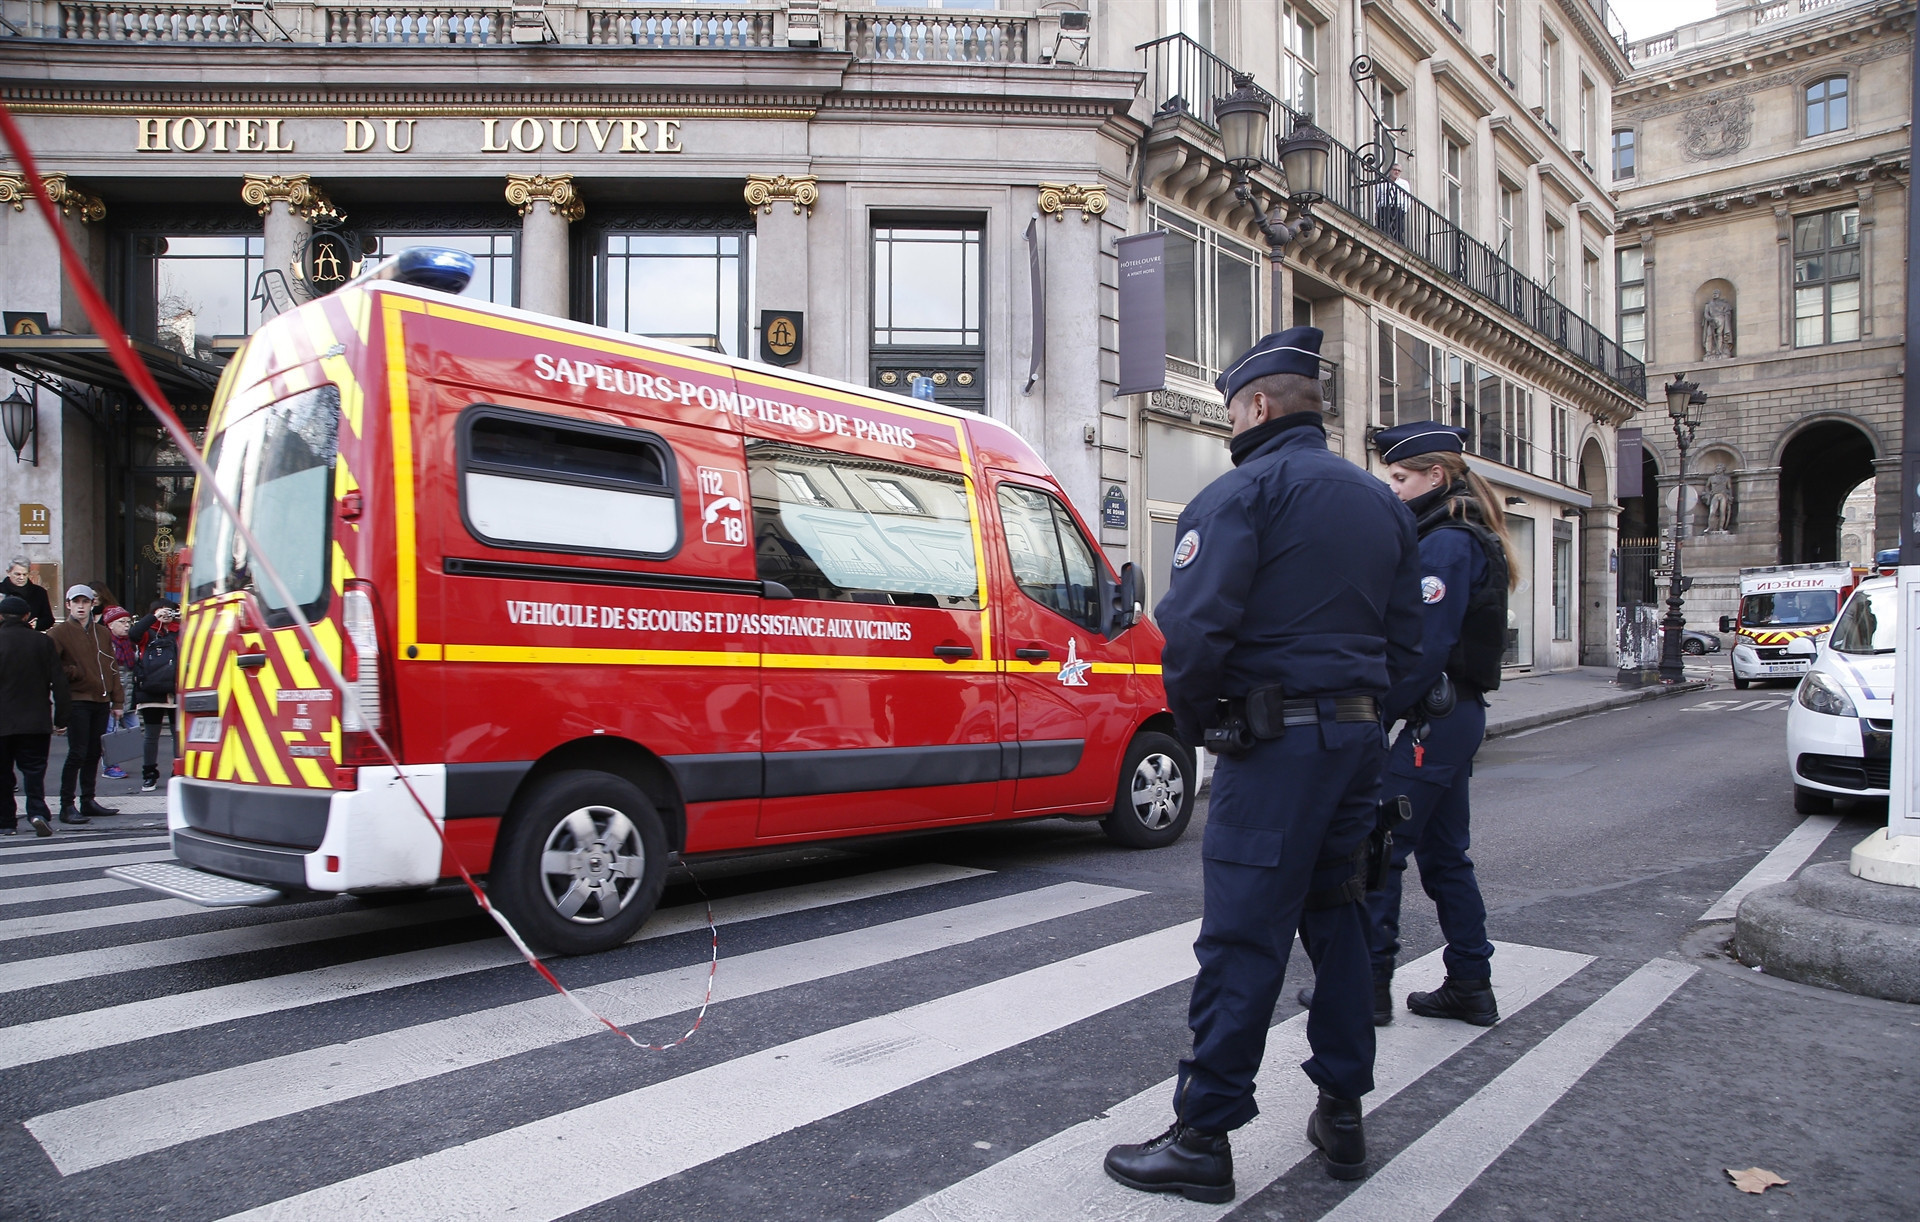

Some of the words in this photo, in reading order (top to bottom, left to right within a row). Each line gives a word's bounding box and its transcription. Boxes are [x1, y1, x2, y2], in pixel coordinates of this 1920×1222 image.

[135, 117, 295, 152] HOTEL
[343, 119, 417, 152] DU
[480, 117, 684, 153] LOUVRE
[534, 353, 813, 430] SAPEURS-POMPIERS
[815, 410, 851, 437] DE
[852, 417, 916, 449] PARIS
[700, 470, 724, 496] 112
[32, 509, 46, 521] H
[720, 516, 743, 542] 18
[506, 600, 599, 628] VEHICULE
[600, 606, 626, 630] DE
[627, 608, 703, 633] SECOURS
[704, 612, 724, 633] ET
[726, 613, 826, 637] D'ASSISTANCE
[826, 618, 854, 639] AUX
[852, 620, 912, 642] VICTIMES
